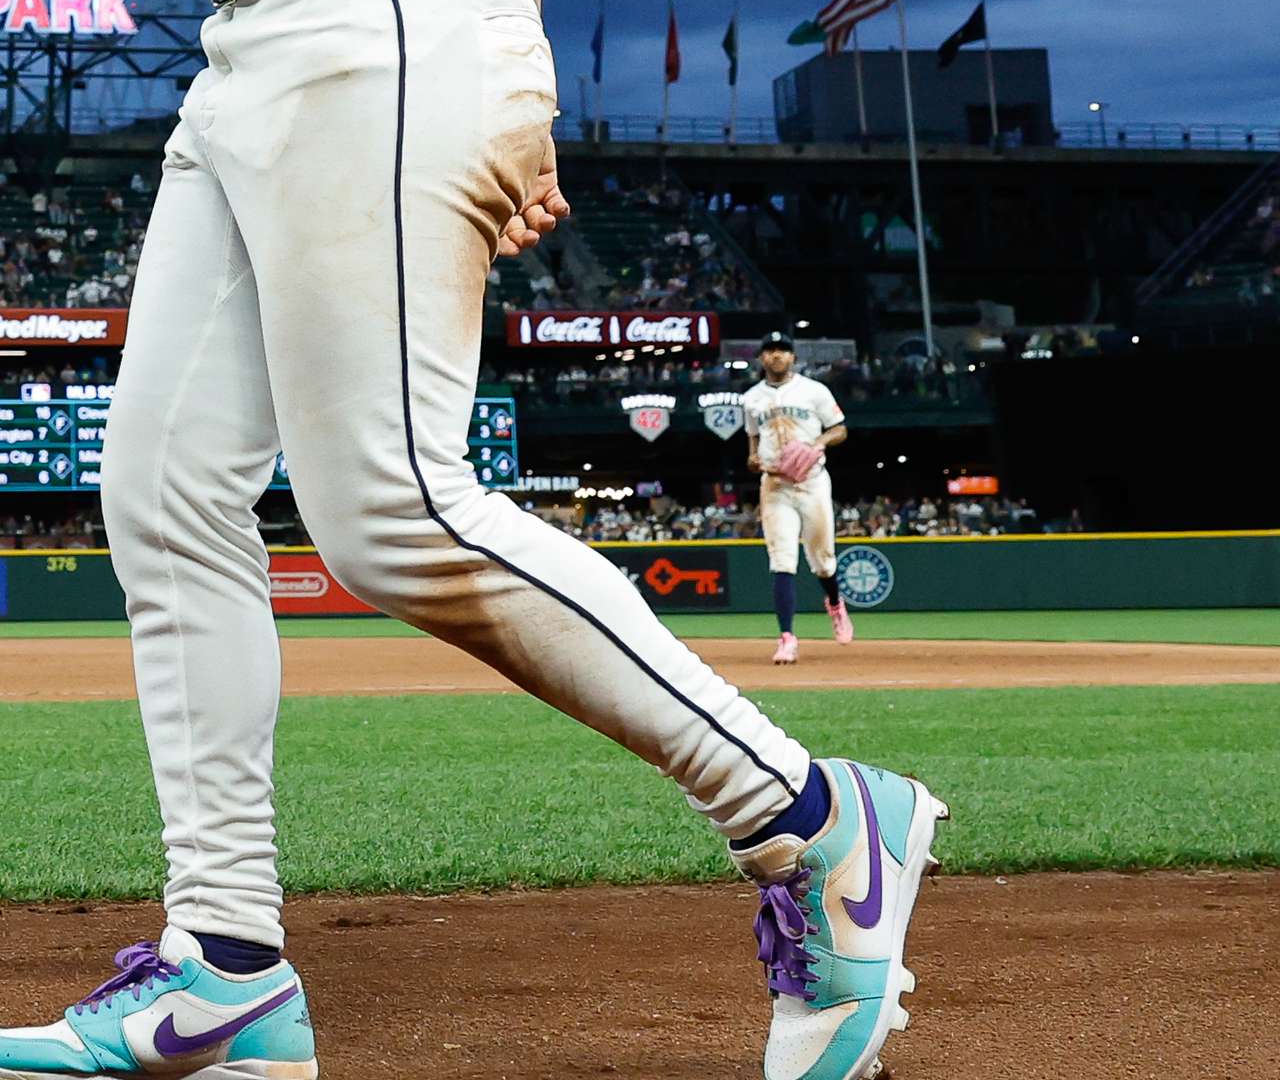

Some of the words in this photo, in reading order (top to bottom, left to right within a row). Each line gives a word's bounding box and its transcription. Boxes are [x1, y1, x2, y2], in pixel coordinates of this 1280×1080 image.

[536, 317, 603, 342] Coca-Cola
[626, 317, 692, 342] Coca-Cola
[636, 410, 662, 429] 42
[713, 408, 737, 428] 24
[47, 557, 77, 572] 376
